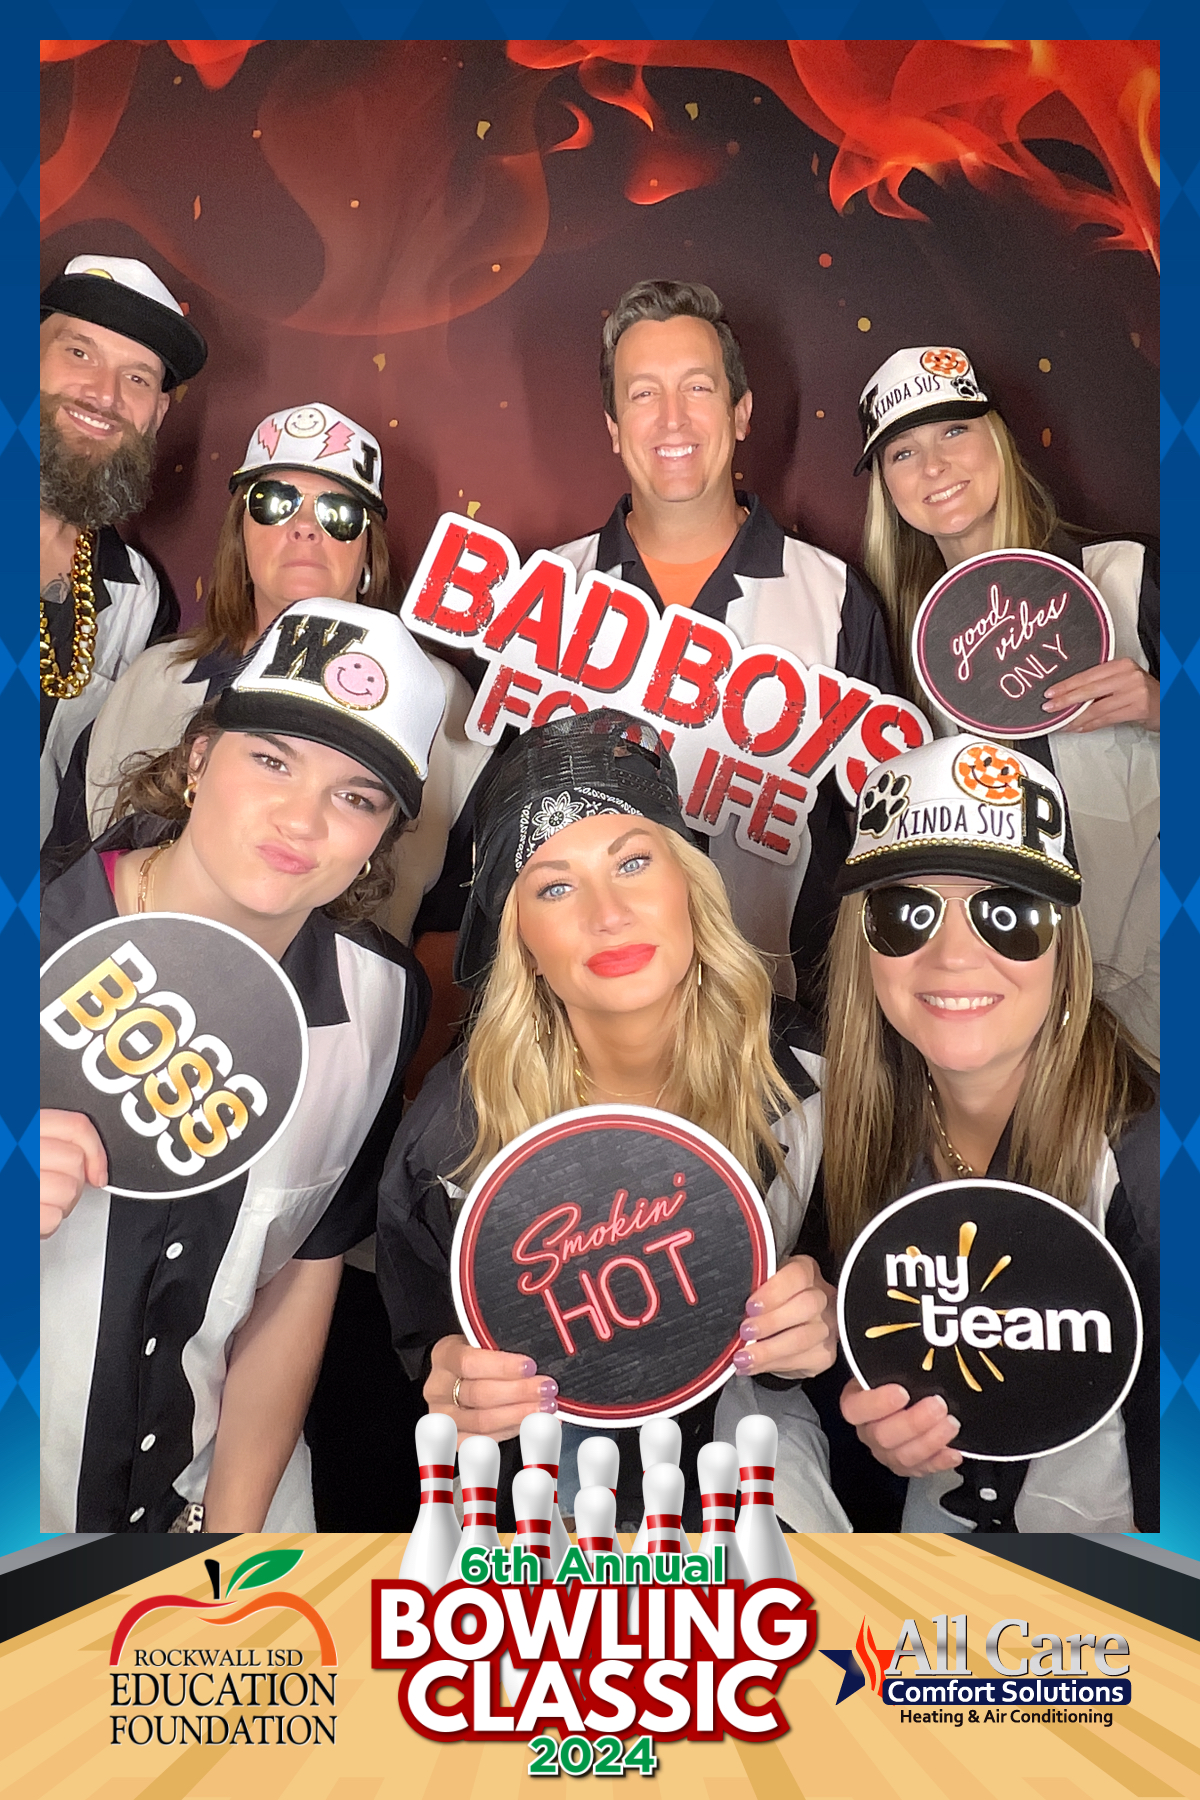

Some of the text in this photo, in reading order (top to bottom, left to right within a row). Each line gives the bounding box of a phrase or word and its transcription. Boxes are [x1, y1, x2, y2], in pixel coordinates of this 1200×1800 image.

[874, 383, 912, 419] KINDA
[914, 375, 941, 395] SUS
[352, 441, 378, 484] J
[259, 614, 369, 686] W
[413, 522, 926, 797] BAD BOYS
[952, 584, 1015, 681] good
[995, 592, 1068, 661] vibes
[999, 633, 1069, 699] ONLY
[660, 730, 808, 854] IFE
[897, 802, 1016, 840] KINDA SUS
[1018, 774, 1063, 851] P
[60, 956, 249, 1158] BOSS
[542, 1228, 698, 1356] HOT
[885, 1253, 969, 1302] my
[921, 1294, 1113, 1354] team
